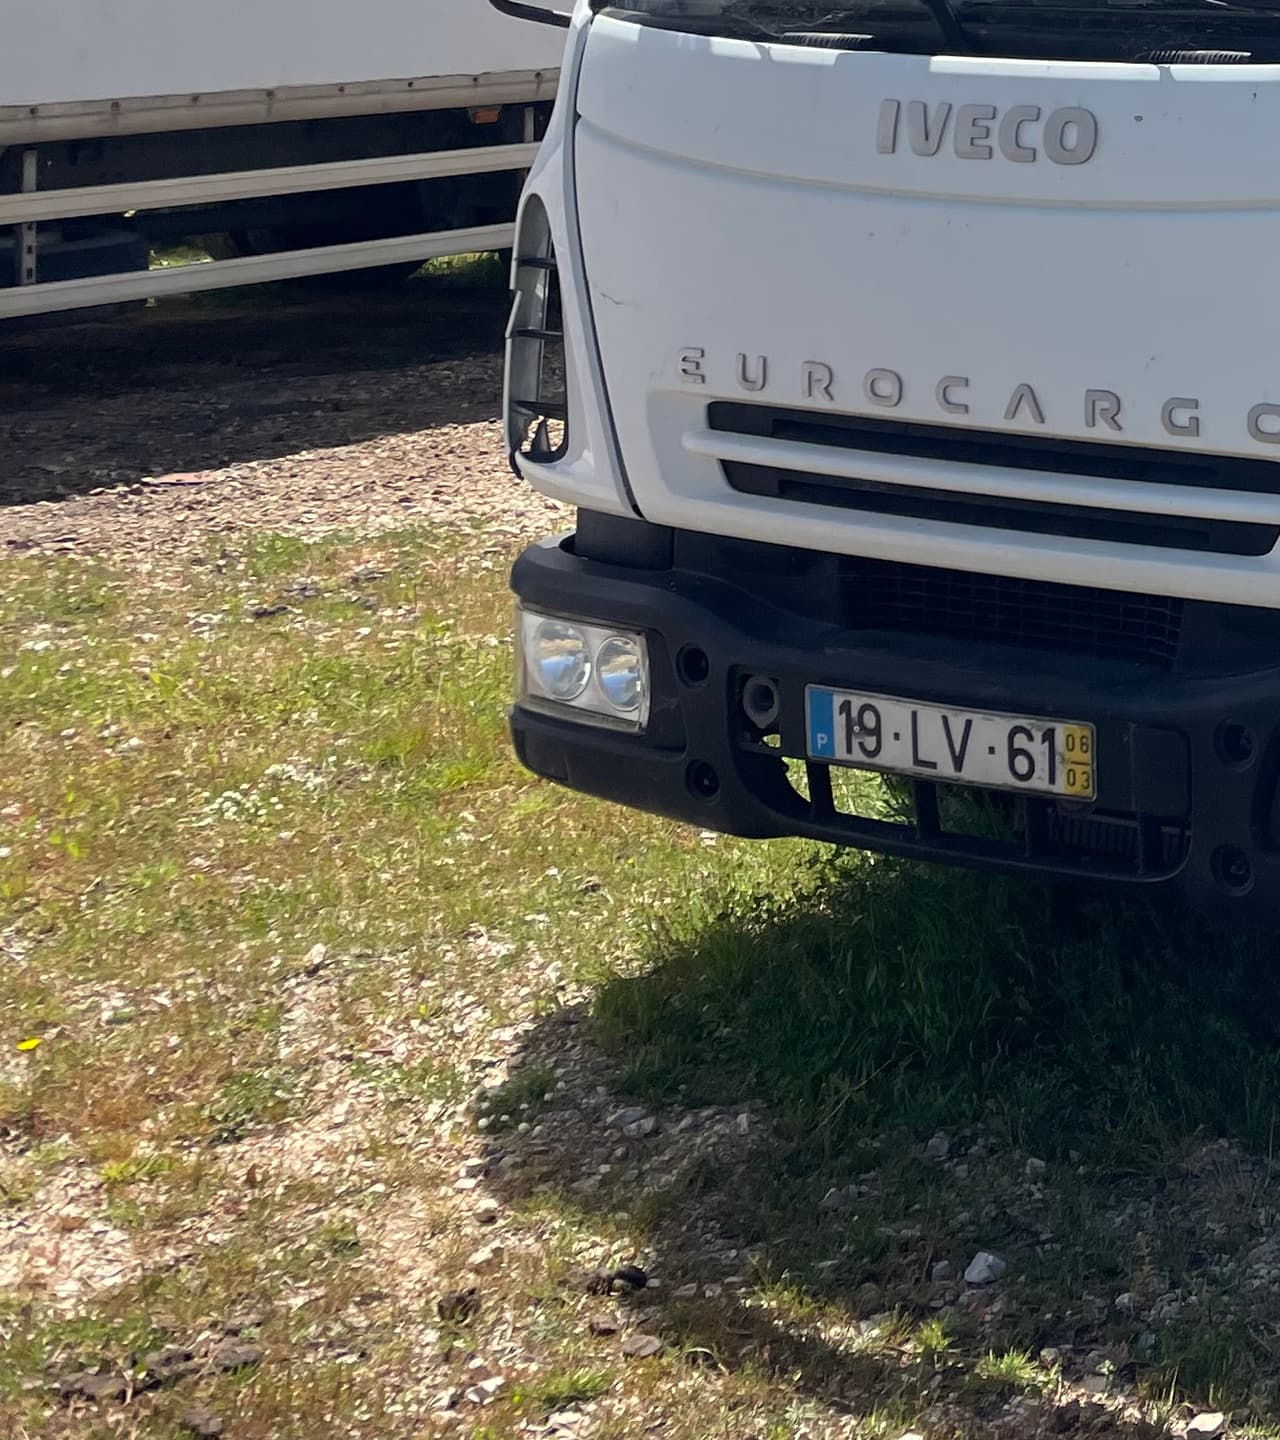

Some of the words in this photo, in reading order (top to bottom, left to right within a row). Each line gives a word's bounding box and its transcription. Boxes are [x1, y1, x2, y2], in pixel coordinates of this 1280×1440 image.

[876, 98, 1098, 165] IVECO
[816, 733, 828, 749] P
[1066, 768, 1090, 790] 03
